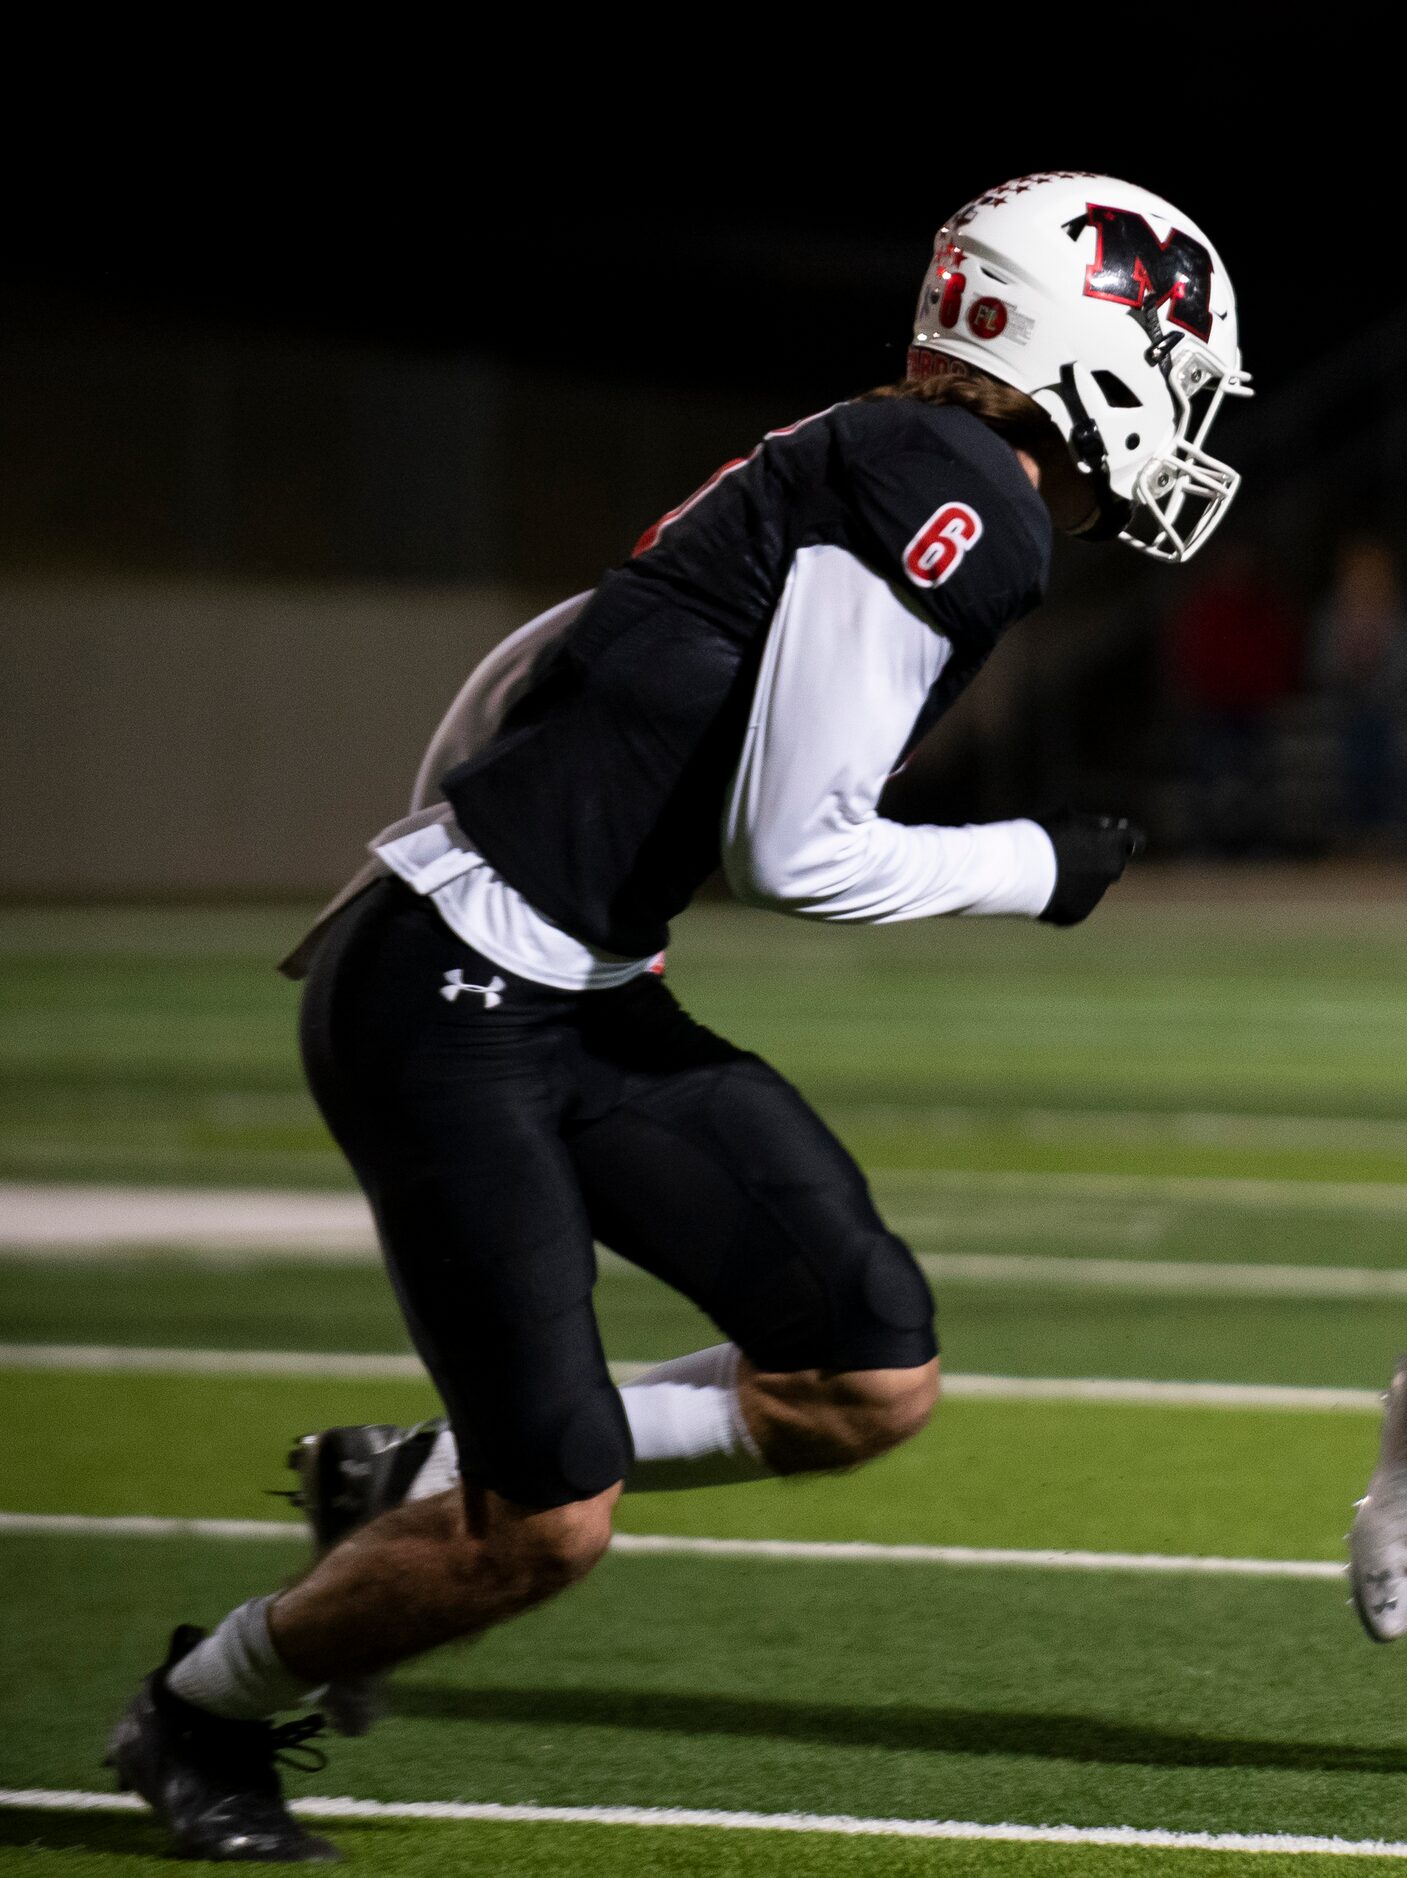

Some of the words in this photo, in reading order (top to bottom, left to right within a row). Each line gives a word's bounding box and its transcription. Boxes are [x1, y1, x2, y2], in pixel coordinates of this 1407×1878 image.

[939, 272, 966, 329] 6
[1083, 202, 1214, 344] M
[902, 501, 983, 588] 6
